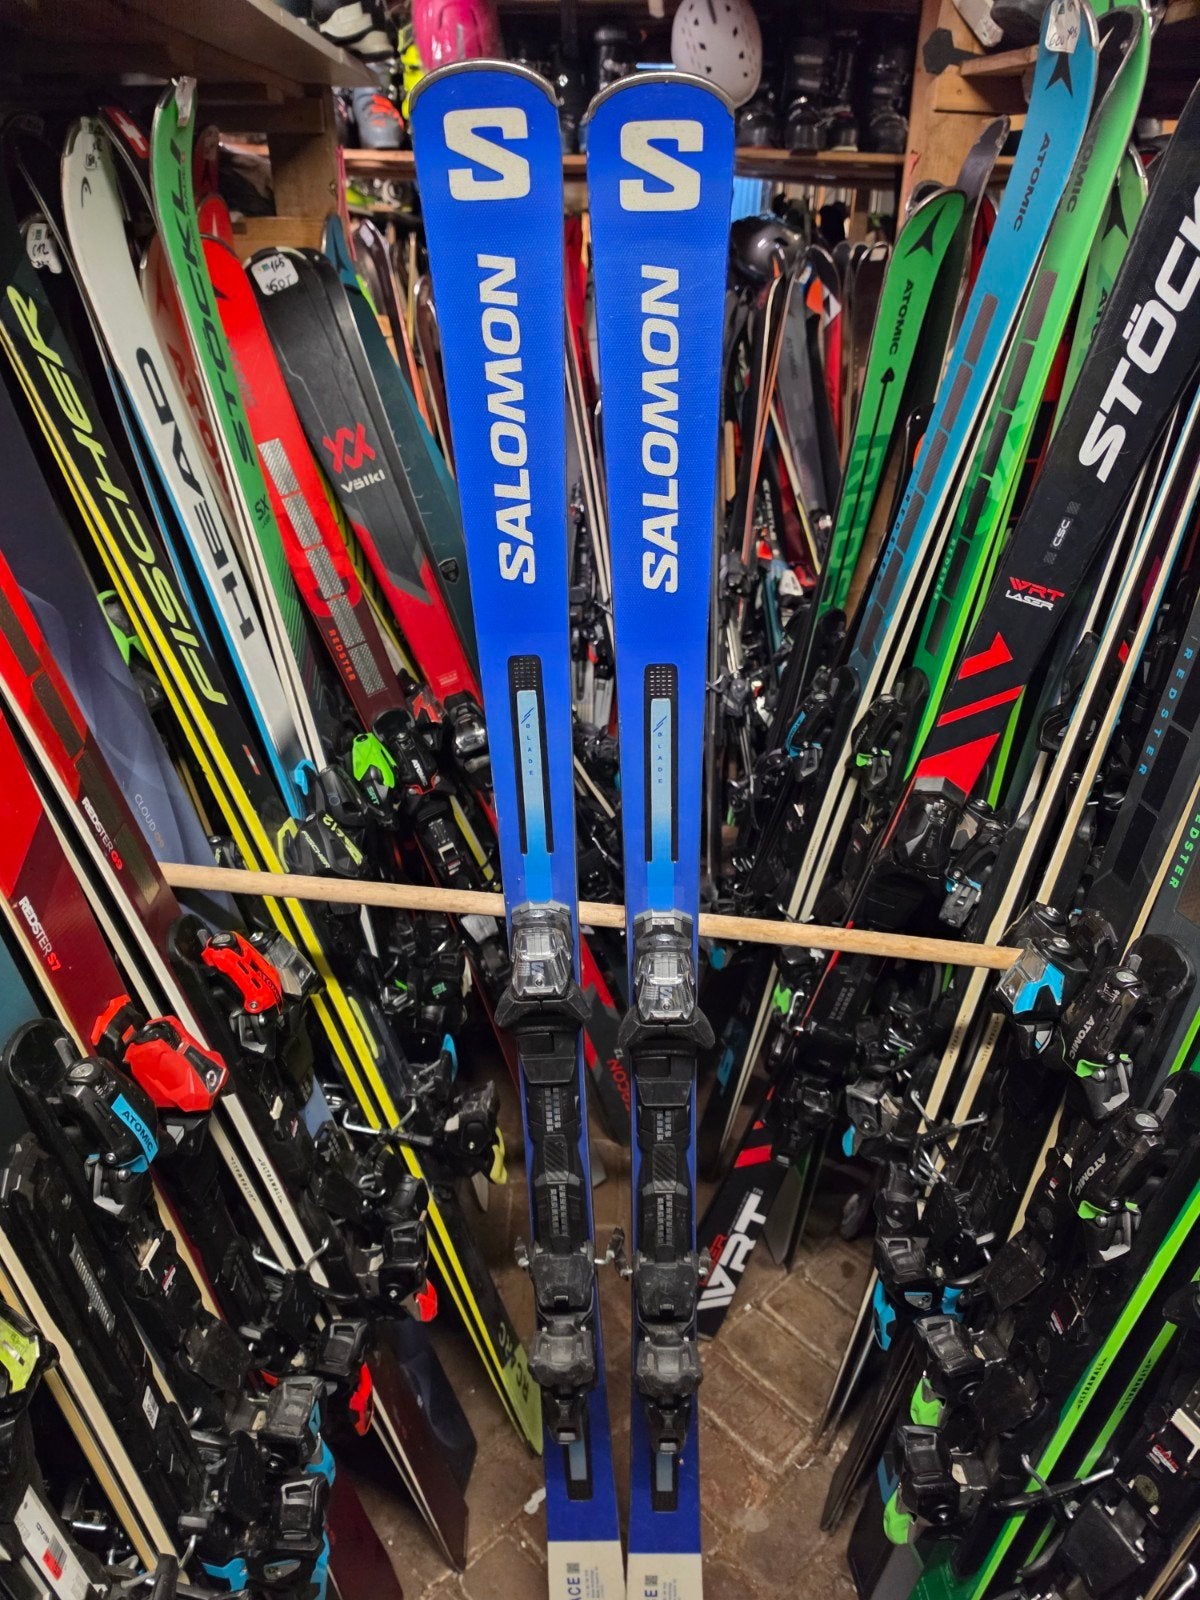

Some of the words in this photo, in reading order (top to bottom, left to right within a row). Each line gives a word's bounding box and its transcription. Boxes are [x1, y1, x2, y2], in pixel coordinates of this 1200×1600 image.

[443, 107, 531, 201] S
[620, 119, 704, 212] S
[1014, 132, 1050, 233] ATOMIC
[1066, 120, 1101, 213] TOMIC
[169, 137, 255, 468] STÖCKLI
[888, 279, 914, 356] ATOMIC
[477, 253, 536, 584] SALOMON
[641, 264, 680, 594] SALOMON
[7, 284, 229, 706] FISCHER
[135, 346, 256, 642] HEAD
[340, 469, 386, 494] Völkl
[875, 493, 912, 586] REDSTER
[1052, 518, 1070, 547] CSC
[934, 538, 956, 601] REDSTER
[1005, 589, 1054, 611] LASER
[1009, 576, 1065, 602] WRT
[328, 628, 356, 682] REDSTER
[1138, 647, 1194, 775] REDSTER
[525, 722, 534, 777] BLADE
[656, 731, 664, 784] BLADE
[81, 795, 114, 852] REDSTER
[134, 793, 156, 832] CLOUD
[301, 830, 331, 869] FISCHER
[18, 895, 53, 957] REDSTER
[1068, 1014, 1095, 1060] ATOMIC
[122, 1110, 154, 1152] ATOMIC
[1074, 1151, 1107, 1197] ATOMIC
[697, 1192, 767, 1310] WRT
